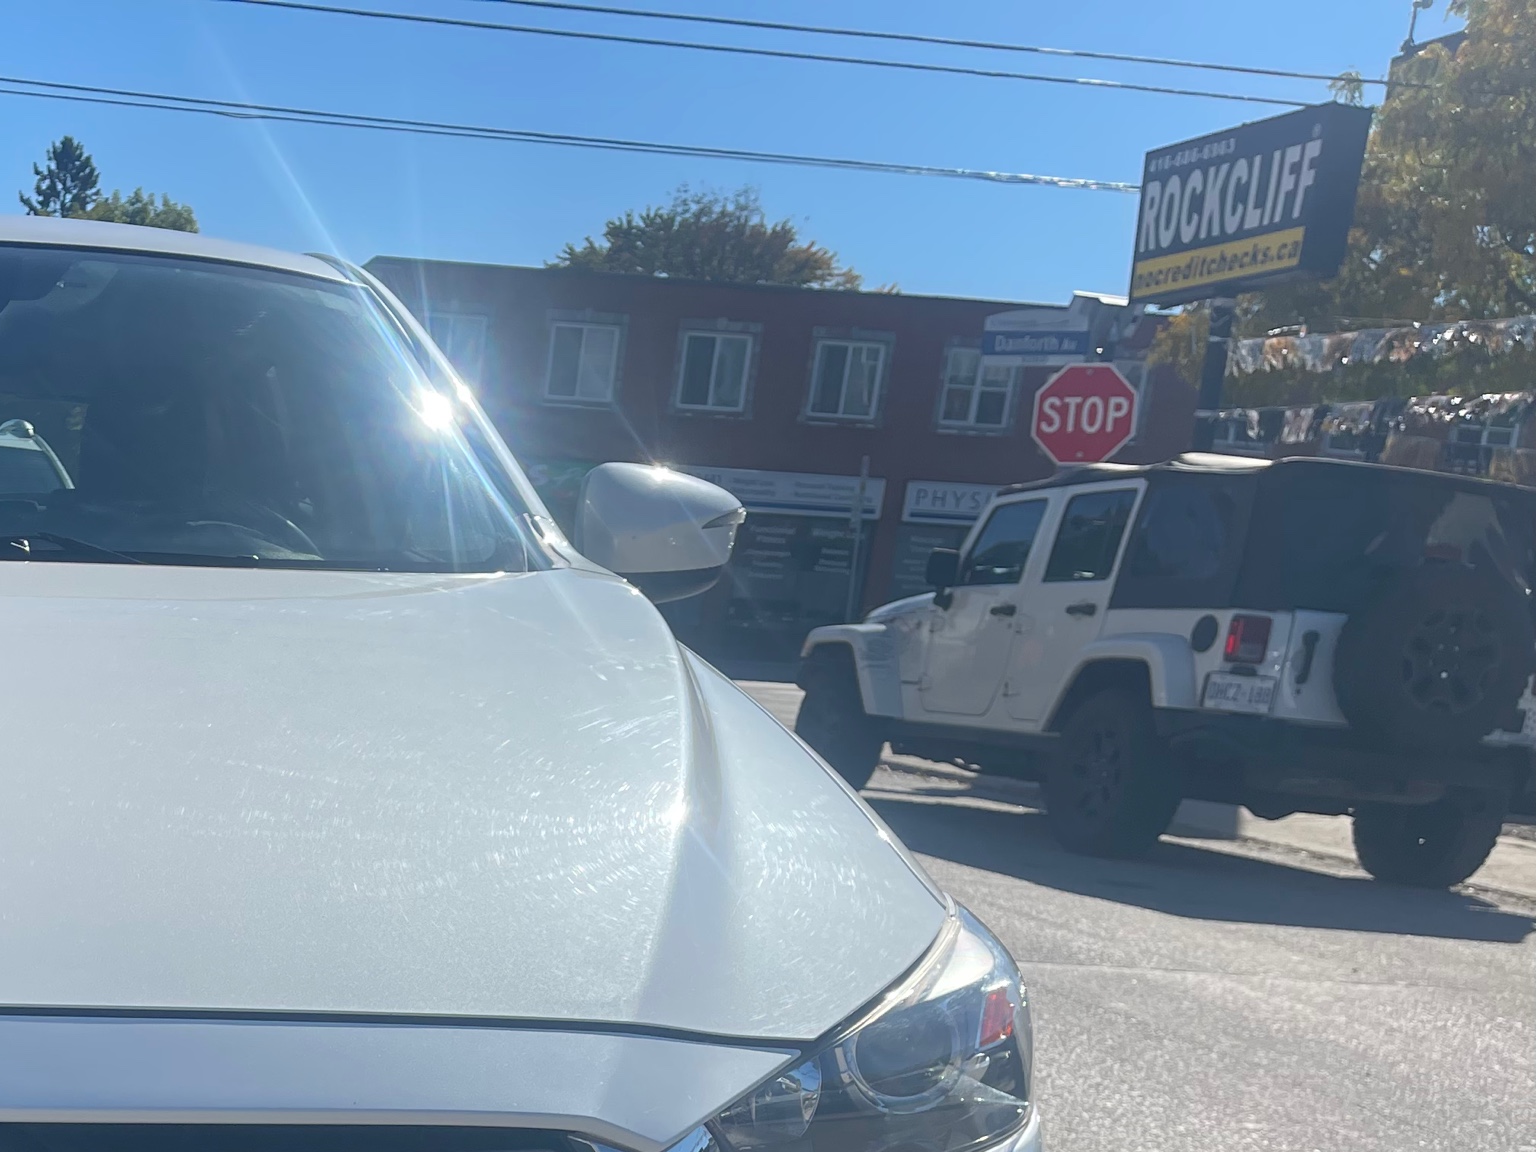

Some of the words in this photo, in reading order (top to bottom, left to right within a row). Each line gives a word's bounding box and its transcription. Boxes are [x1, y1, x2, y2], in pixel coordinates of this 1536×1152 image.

[1139, 139, 1323, 252] ROCKCLIFF
[1137, 240, 1300, 288] nocreditchecks.ca
[1039, 396, 1129, 433] STOP
